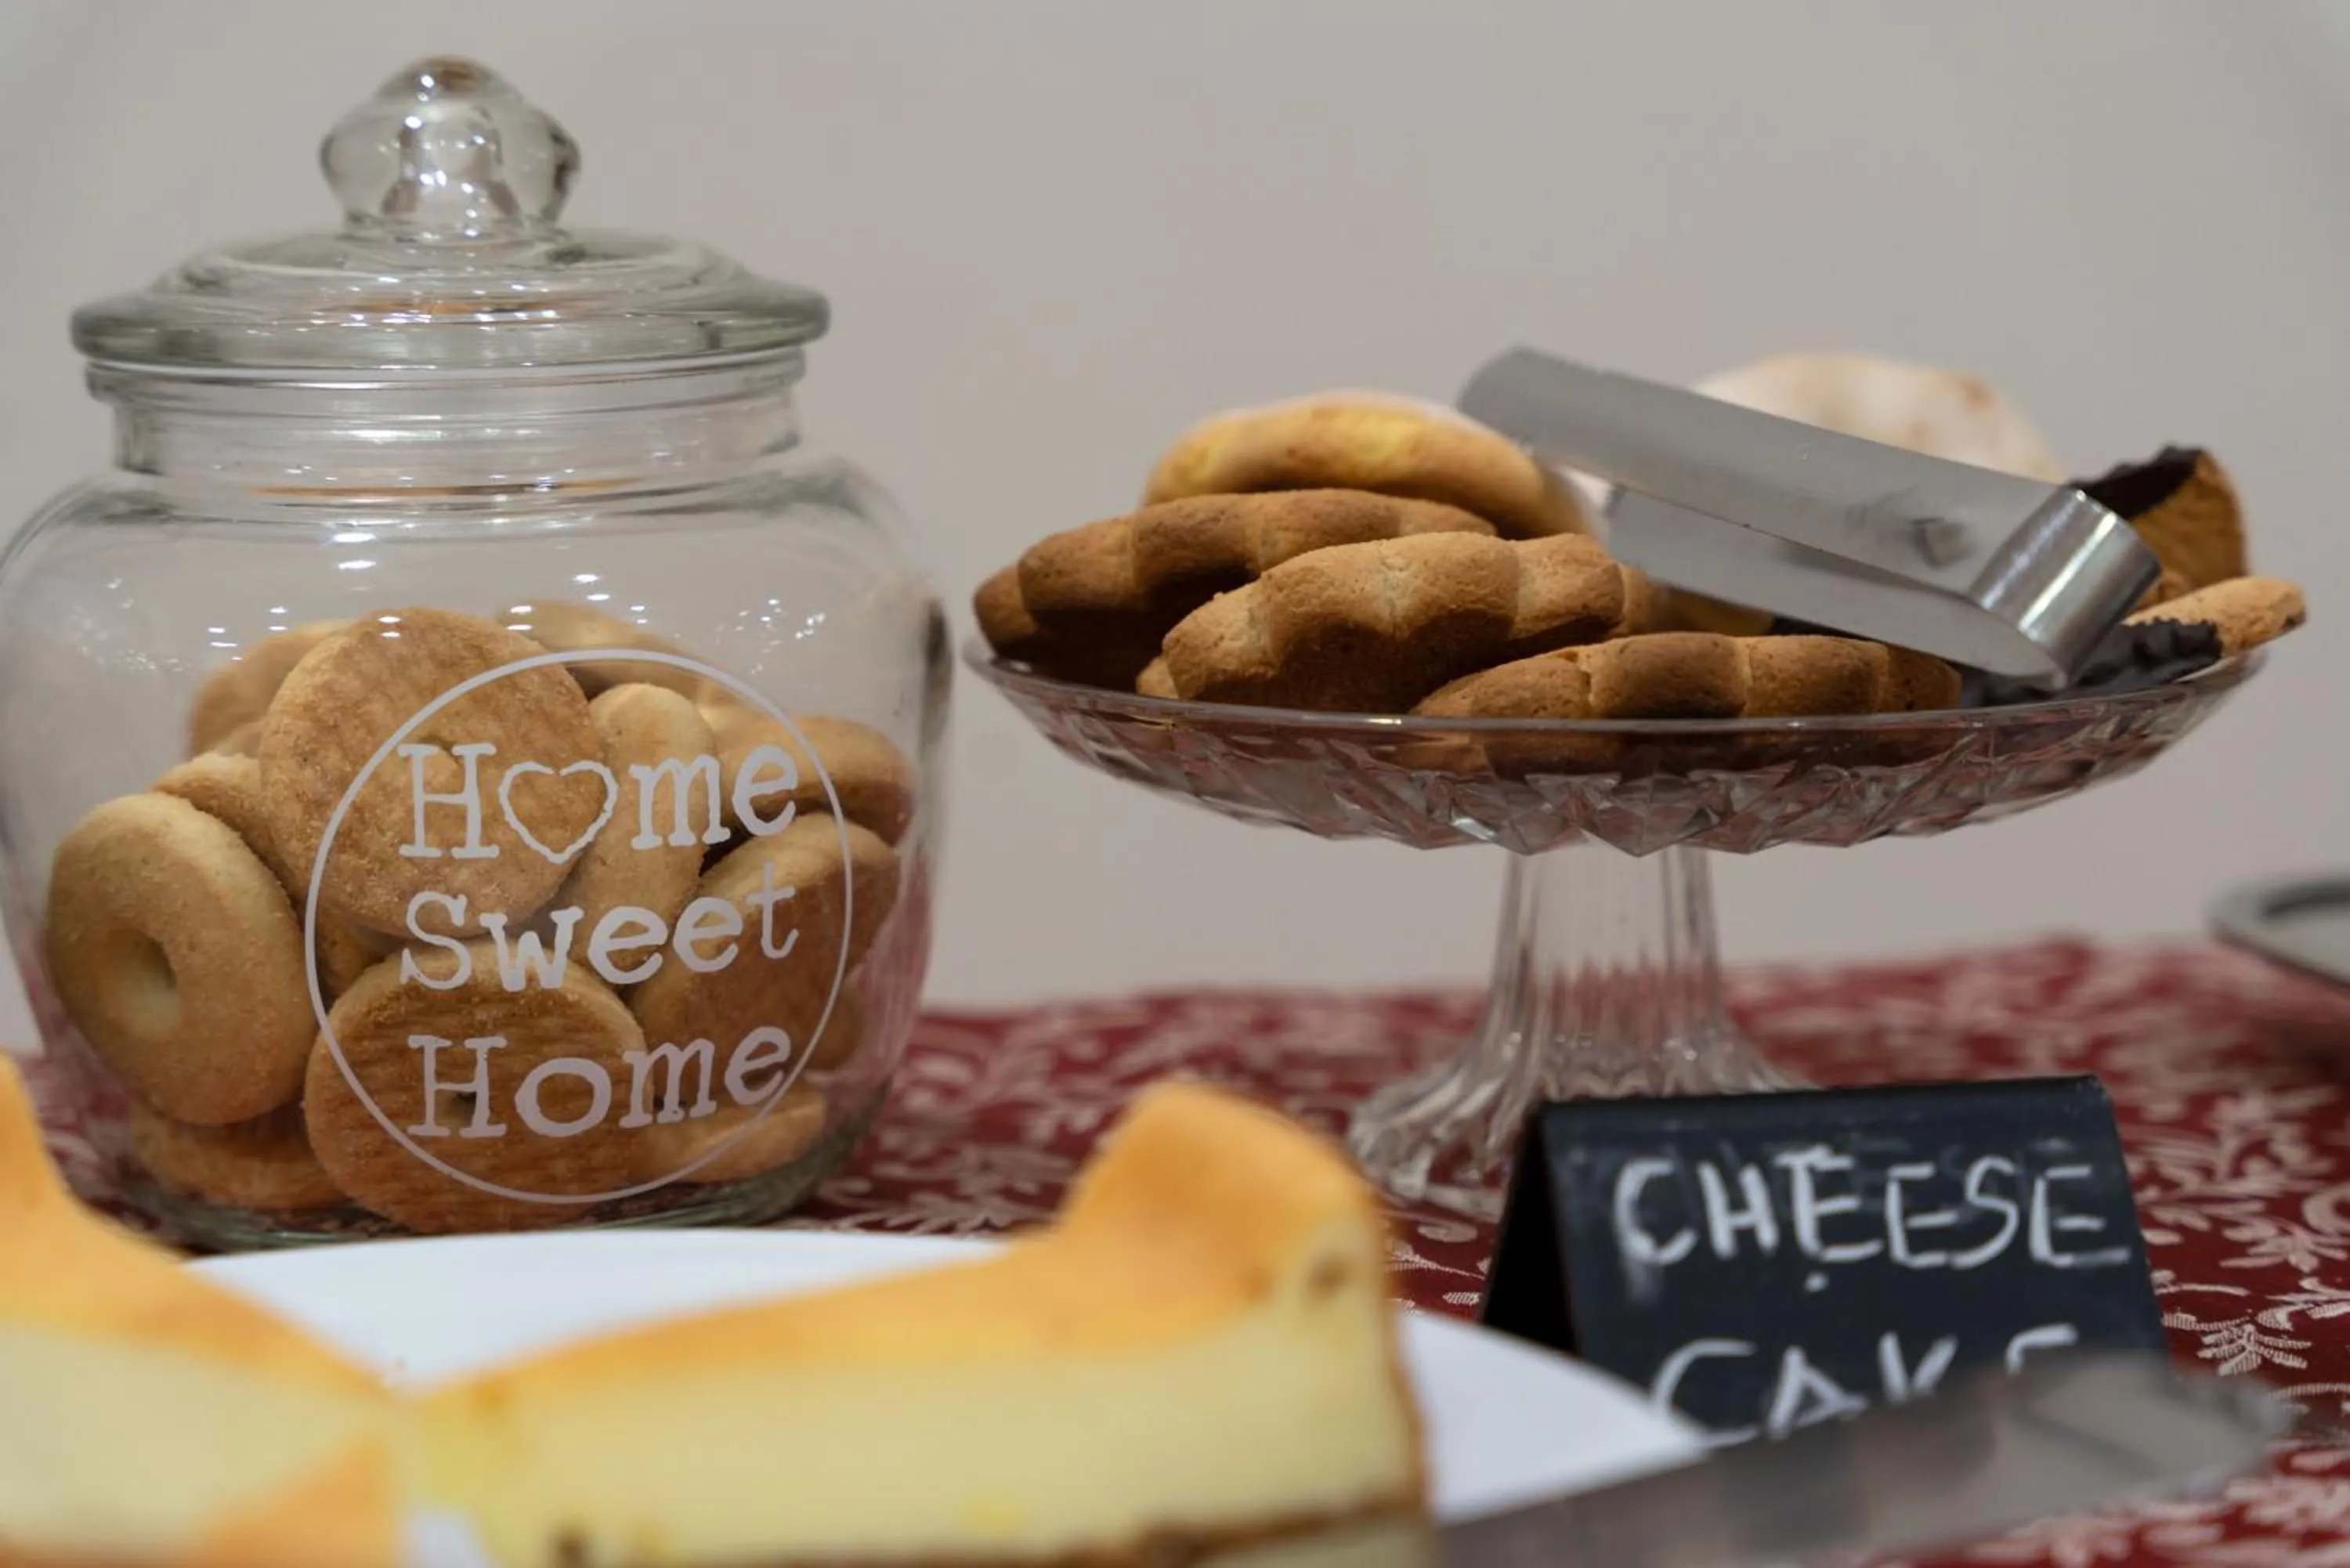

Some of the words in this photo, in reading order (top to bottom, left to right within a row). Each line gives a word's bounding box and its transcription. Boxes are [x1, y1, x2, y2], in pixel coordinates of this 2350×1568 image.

[400, 862, 798, 992] Sweet
[407, 1026, 791, 1138] Home
[1614, 1146, 2131, 1268] CHEESE
